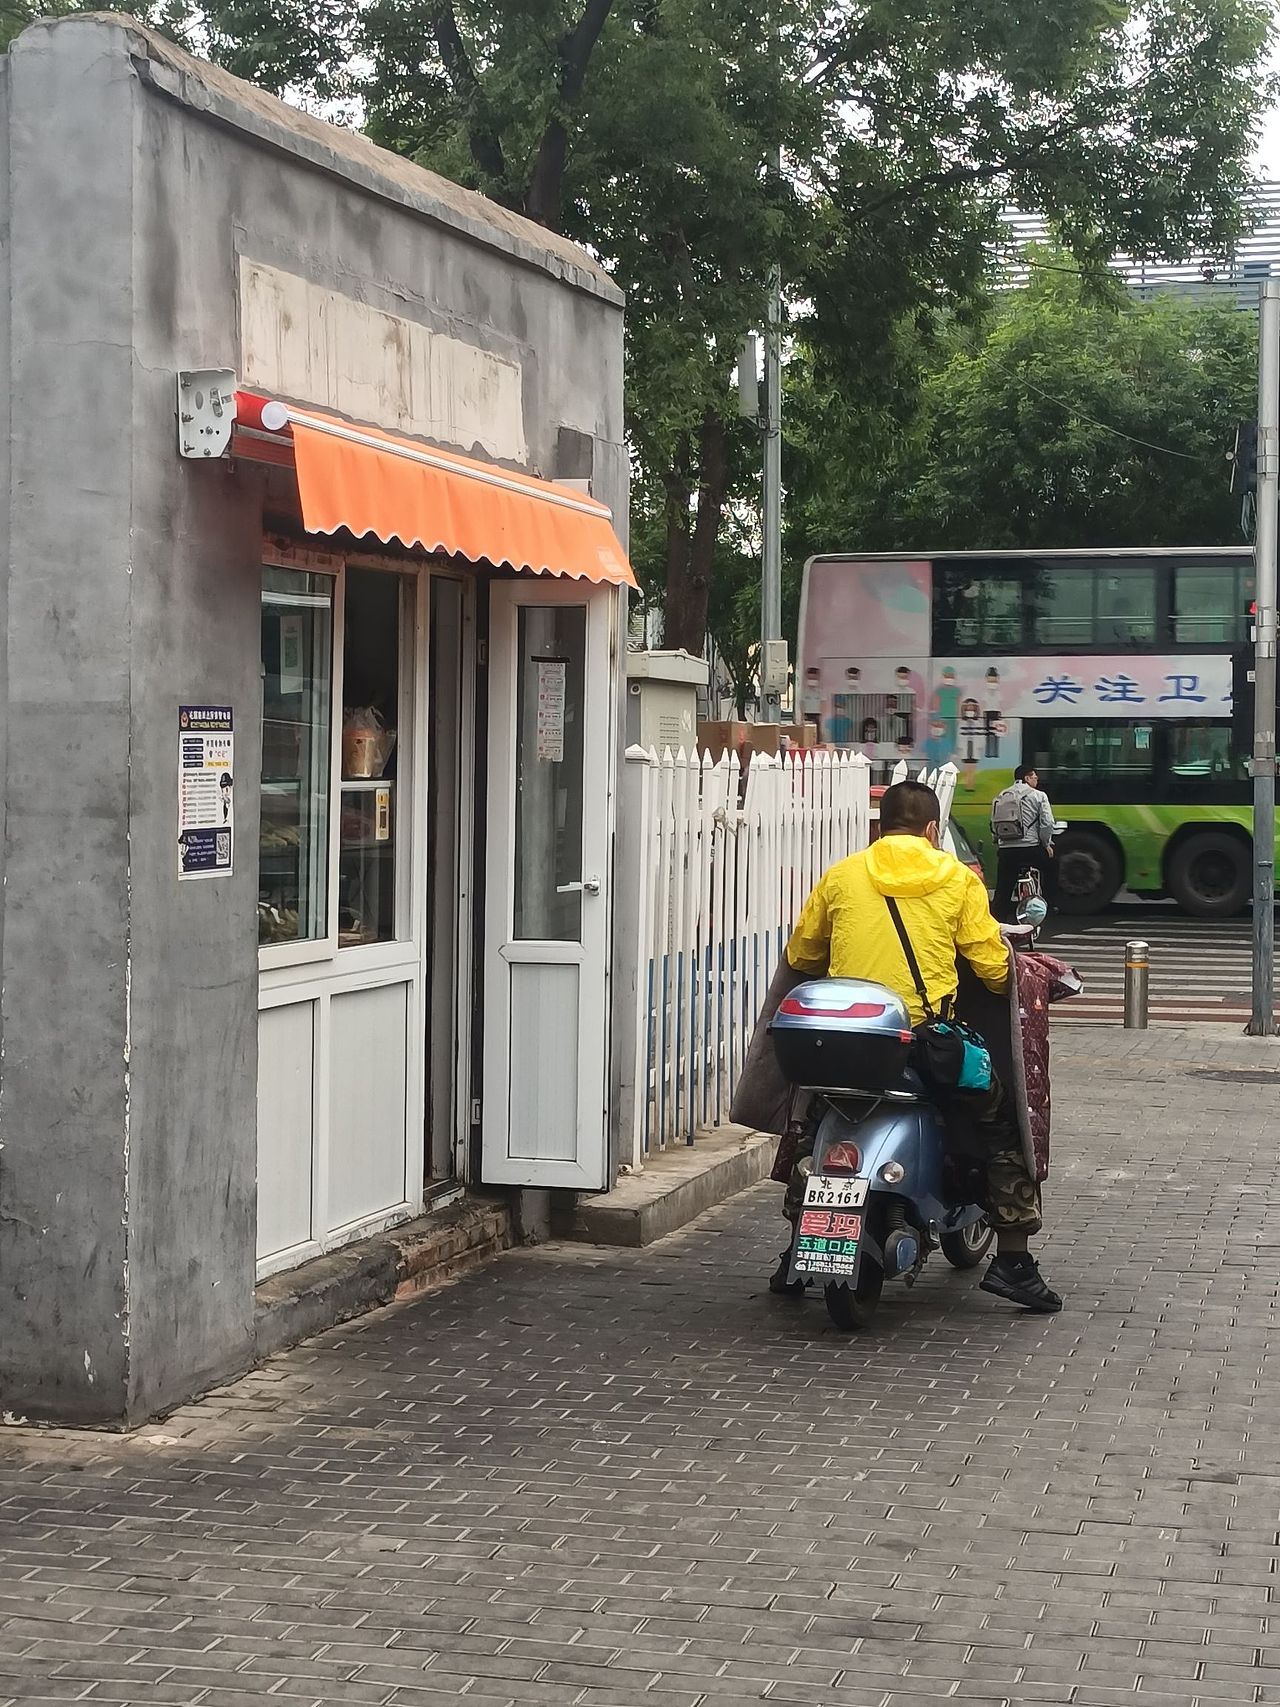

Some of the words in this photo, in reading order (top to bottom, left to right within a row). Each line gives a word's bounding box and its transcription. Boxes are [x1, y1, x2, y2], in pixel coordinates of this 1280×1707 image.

[1033, 674, 1232, 704] 关注卫
[808, 1190, 860, 1204] BR2161
[797, 1237, 858, 1255] 五道口店
